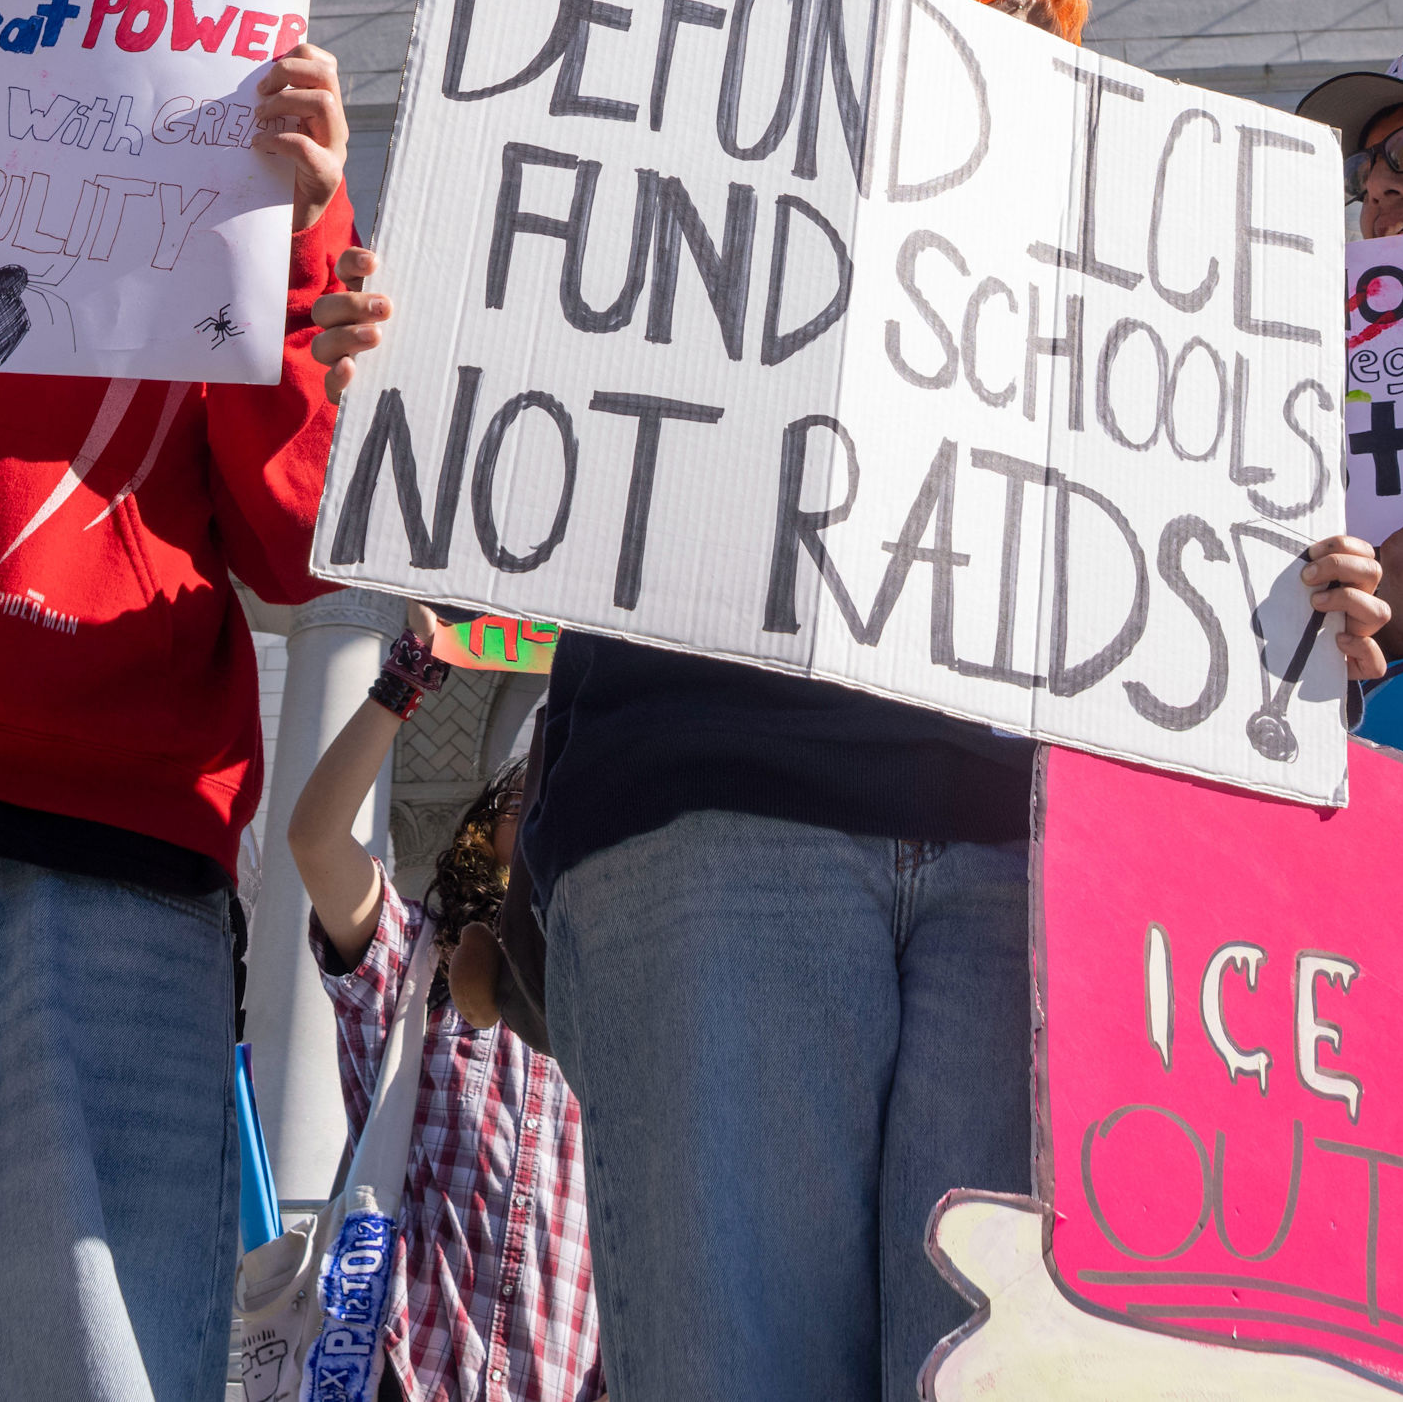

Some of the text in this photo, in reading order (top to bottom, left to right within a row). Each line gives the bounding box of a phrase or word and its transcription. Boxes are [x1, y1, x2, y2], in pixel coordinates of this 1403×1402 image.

[152, 96, 296, 154] GRE
[1025, 57, 1323, 345] ICE
[485, 140, 1332, 520] FUND SCHOOLS
[330, 366, 1340, 763] NOT RAIDS!
[1144, 920, 1364, 1124] ICE
